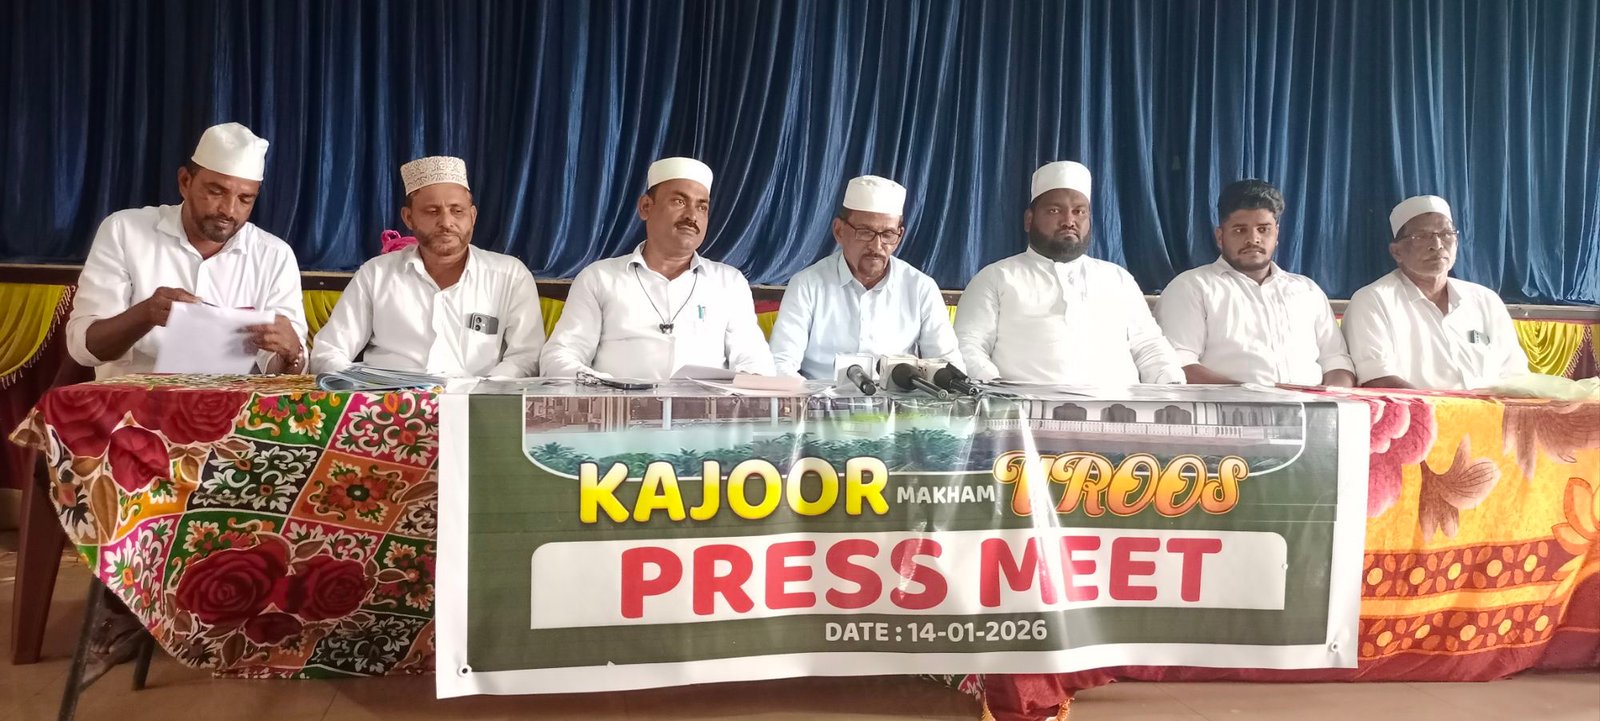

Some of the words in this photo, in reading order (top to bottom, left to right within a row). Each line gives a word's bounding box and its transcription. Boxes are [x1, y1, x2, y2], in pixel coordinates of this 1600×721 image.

[579, 457, 889, 524] KAJOOR
[897, 485, 994, 504] MAKHAM
[992, 451, 1248, 517] UROOS
[620, 537, 948, 618] PRESS
[979, 535, 1223, 608] MEET
[825, 622, 889, 641] DATE
[906, 620, 1048, 643] 14-01-2026
